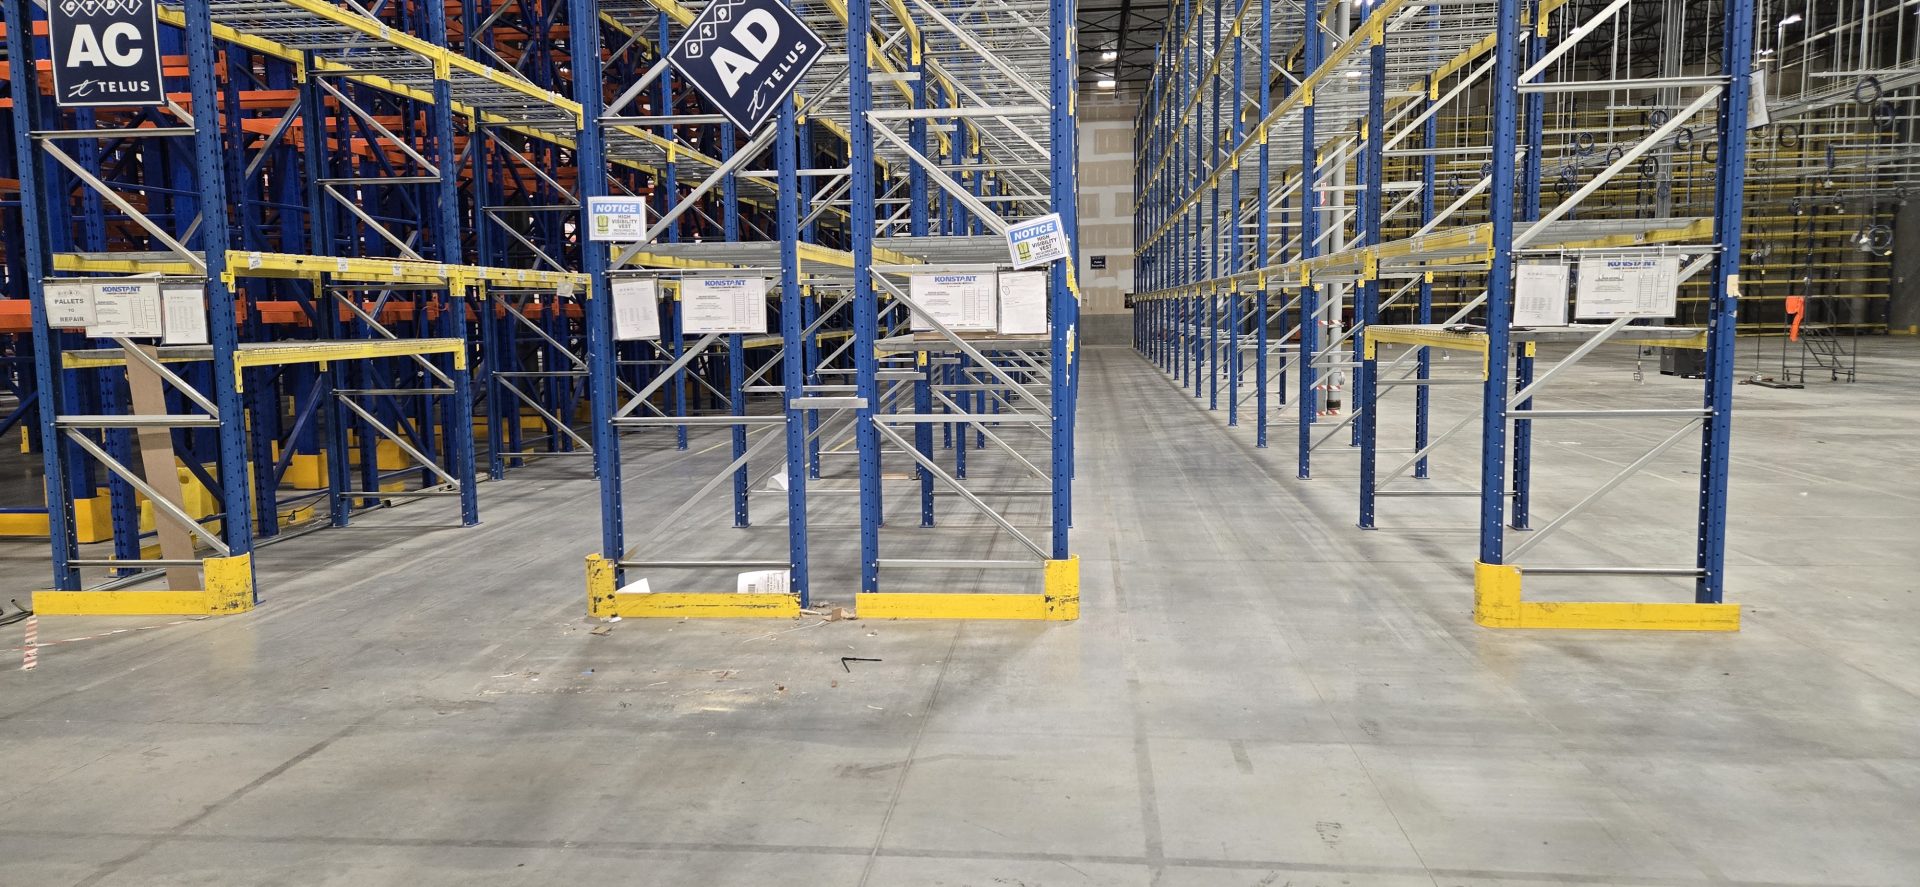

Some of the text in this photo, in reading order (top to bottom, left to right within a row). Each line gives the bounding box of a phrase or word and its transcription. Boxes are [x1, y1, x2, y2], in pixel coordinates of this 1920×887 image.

[66, 22, 143, 67] AC
[710, 8, 780, 98] AD
[764, 41, 807, 89] TELUS
[98, 81, 150, 92] TELUS
[596, 204, 637, 213] NOTICE
[1014, 222, 1054, 241] NOTICE
[1031, 237, 1057, 248] VISIBILITY
[1039, 243, 1052, 251] VEST
